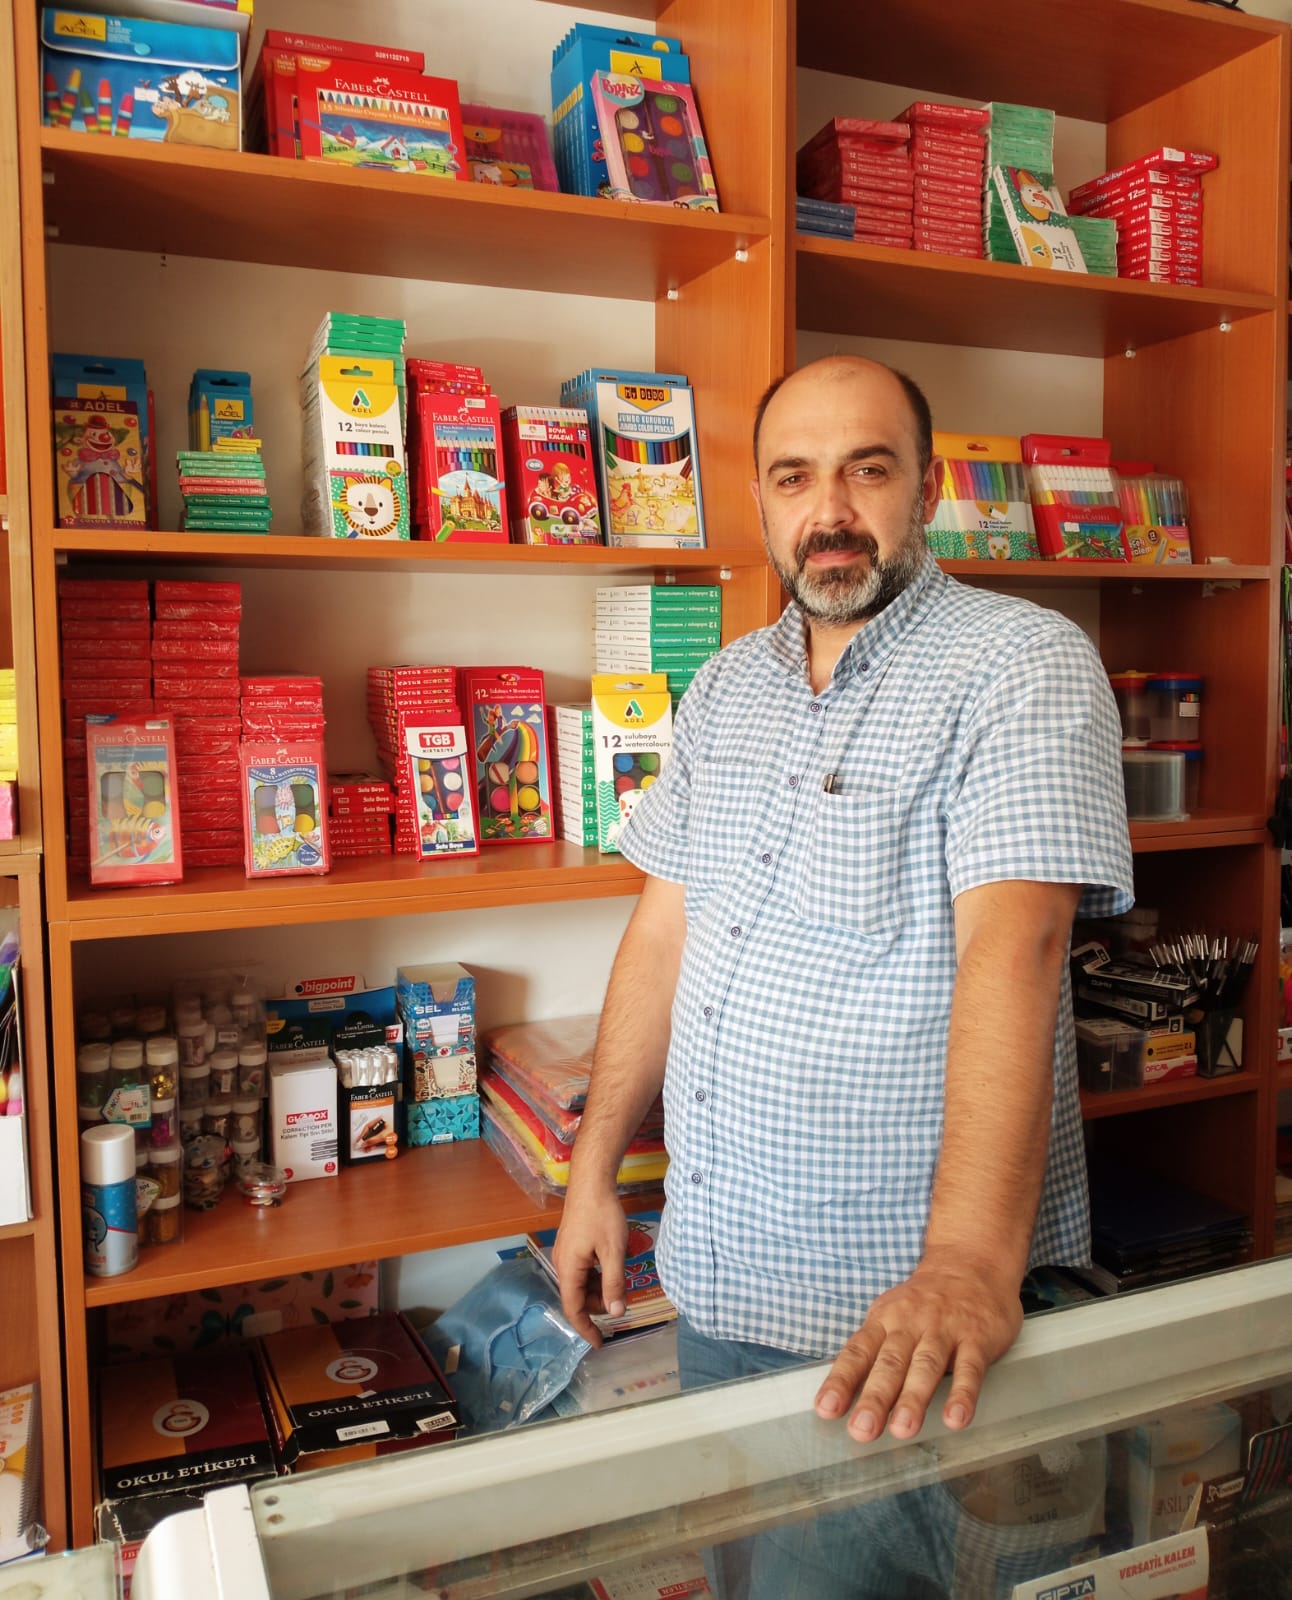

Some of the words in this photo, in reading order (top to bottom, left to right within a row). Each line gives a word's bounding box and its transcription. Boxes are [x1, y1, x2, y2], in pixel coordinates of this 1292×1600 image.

[84, 401, 124, 413] ADEL
[218, 410, 242, 418] ADEL
[338, 422, 353, 432] 12
[475, 688, 489, 700] 12
[423, 734, 451, 746] TGB
[602, 735, 622, 748] 12
[270, 767, 276, 775] 8
[304, 979, 353, 993] bigpoint
[308, 1403, 359, 1417] OKUL
[362, 1391, 433, 1409] ETİKETİ
[117, 1468, 174, 1489] OKUL
[176, 1453, 258, 1478] ETİKETİ
[1164, 1546, 1196, 1566] KALEM
